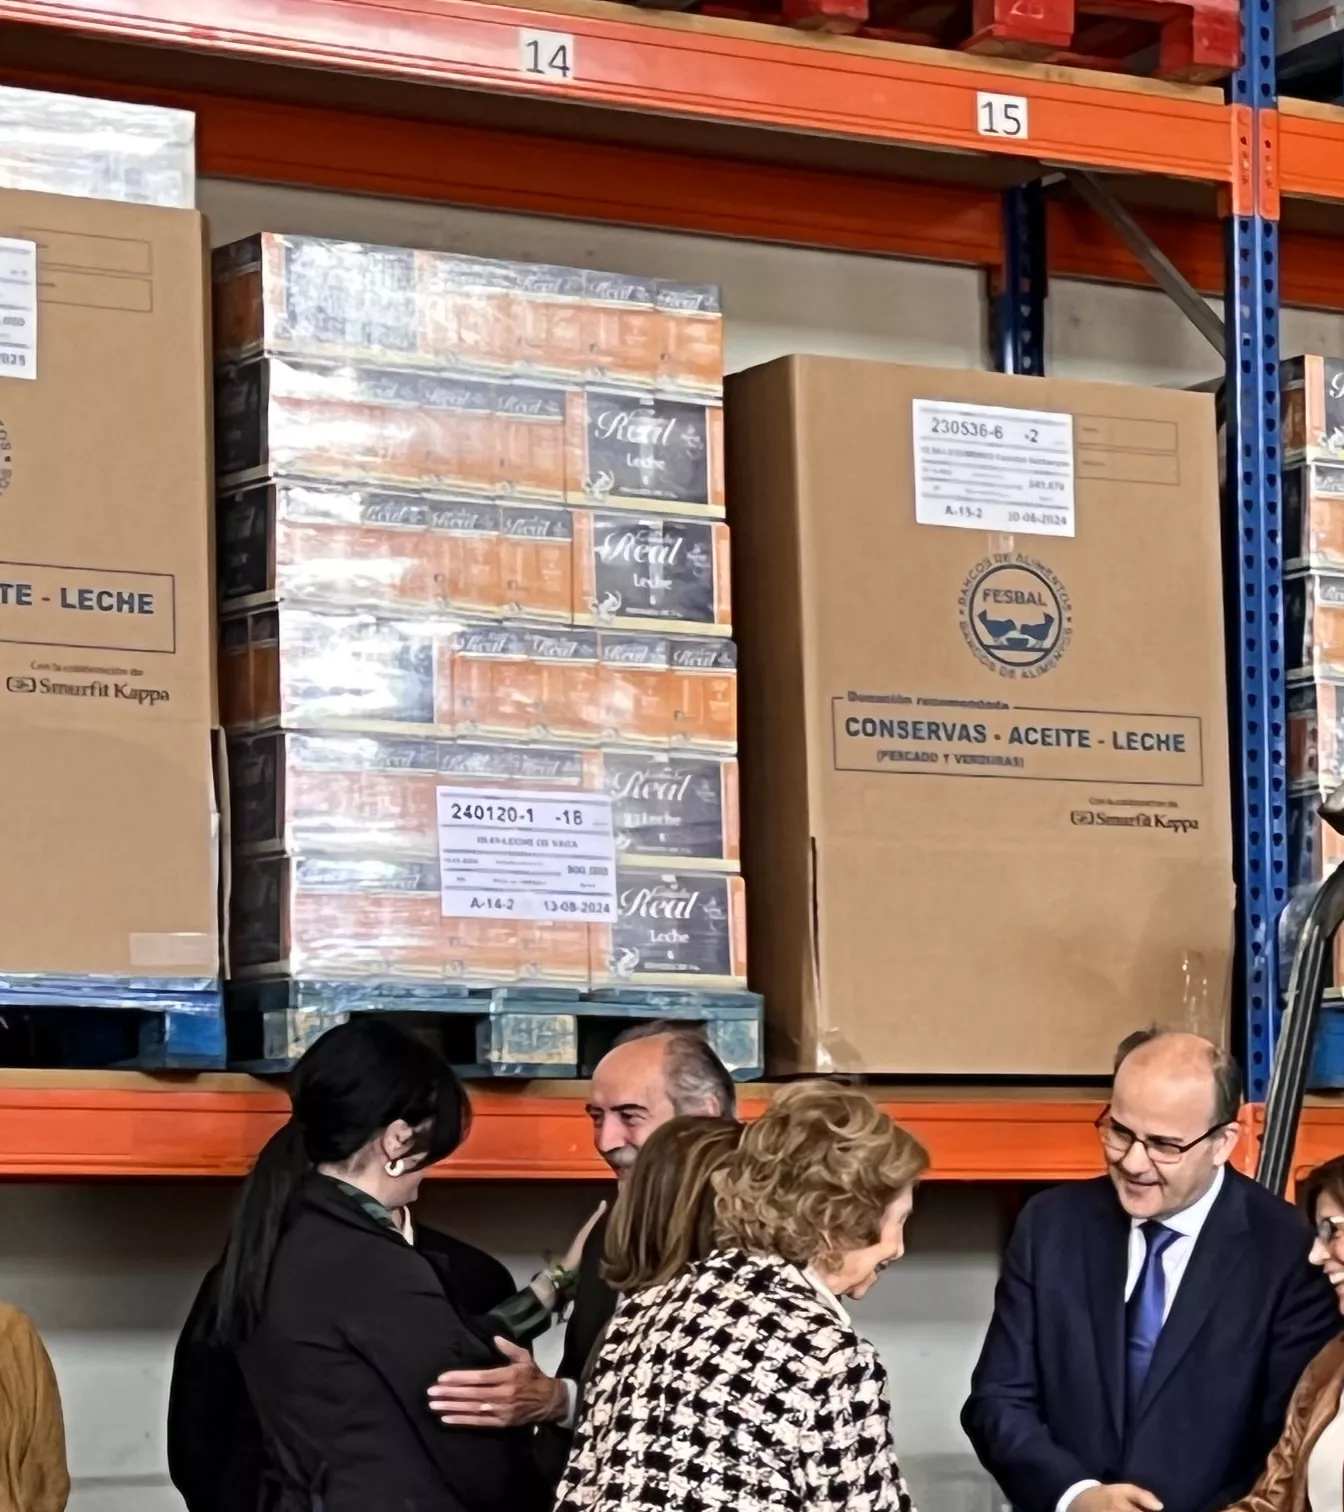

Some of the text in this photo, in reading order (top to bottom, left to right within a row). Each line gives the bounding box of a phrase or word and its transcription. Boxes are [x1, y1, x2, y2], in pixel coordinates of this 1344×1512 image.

[524, 40, 570, 77] 14
[980, 101, 1021, 135] 15
[595, 411, 676, 446] Real
[931, 417, 1003, 439] 230536-6
[600, 532, 683, 565] Real
[61, 587, 154, 614] LECHE
[983, 588, 1047, 607] FESBAL
[39, 678, 170, 706] Smurfit Kappa
[845, 717, 987, 744] CONSERVAS
[1008, 727, 1091, 748] ACEITE
[1112, 731, 1186, 753] LECHE
[611, 771, 692, 801] Real
[452, 803, 534, 823] 240120-1
[1154, 814, 1199, 833] Kappa
[617, 888, 699, 919] Real
[650, 930, 690, 944] Leche
